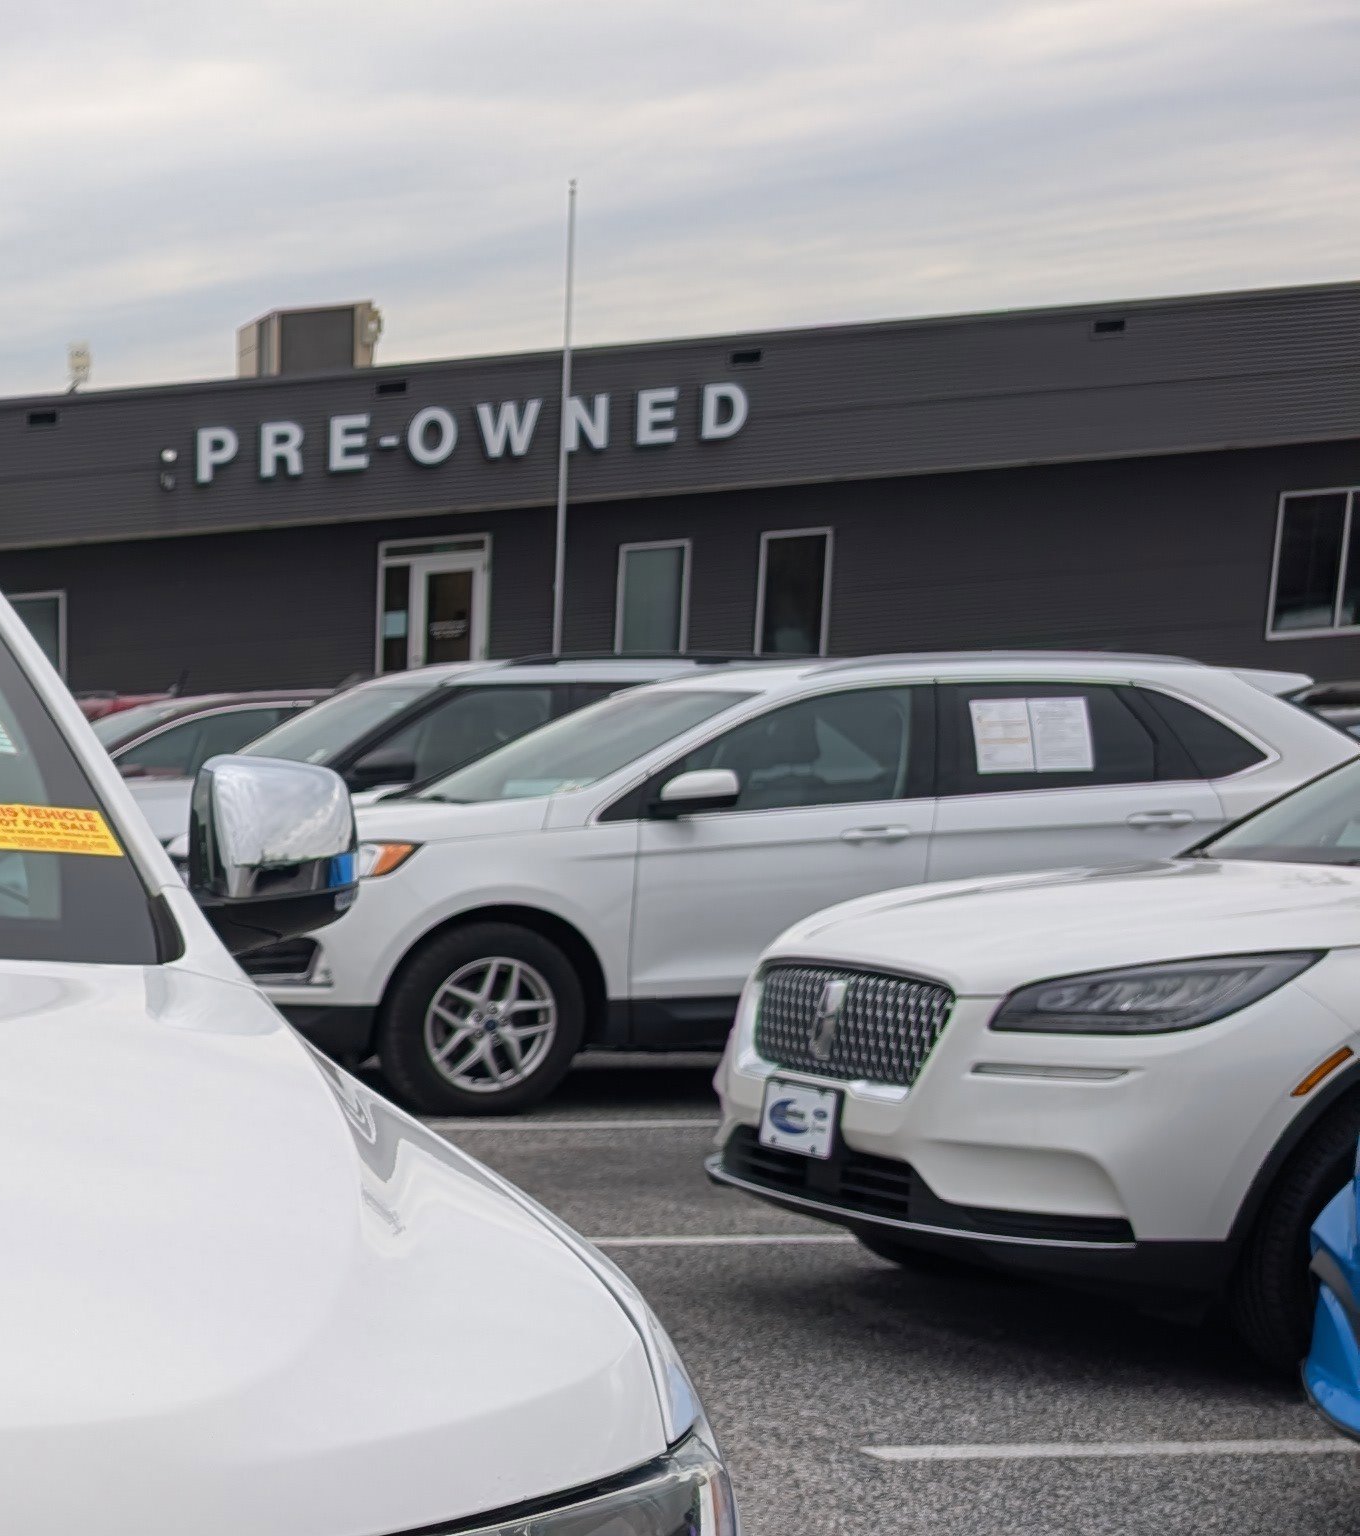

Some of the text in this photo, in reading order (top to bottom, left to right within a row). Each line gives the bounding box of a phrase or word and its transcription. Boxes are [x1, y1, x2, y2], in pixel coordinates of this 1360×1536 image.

[196, 381, 749, 483] PRE-OWNED
[21, 807, 97, 823] VEHICLE
[22, 819, 54, 829] FOR
[59, 822, 99, 832] SALE
